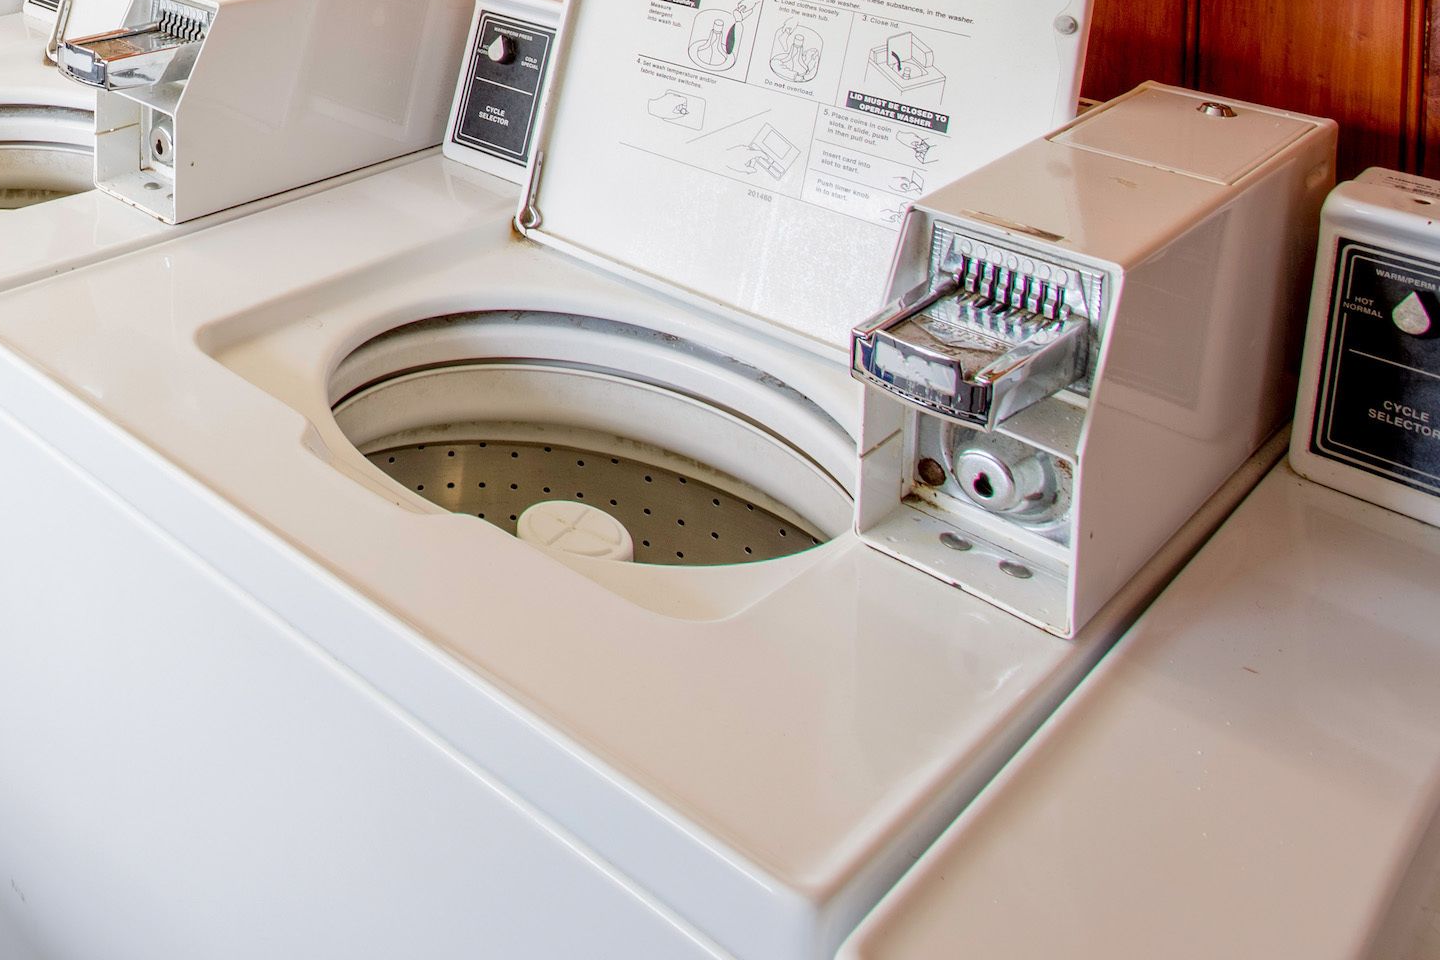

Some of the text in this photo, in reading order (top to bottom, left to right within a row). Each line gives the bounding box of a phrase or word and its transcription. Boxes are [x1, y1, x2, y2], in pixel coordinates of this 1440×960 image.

[837, 0, 860, 9] washer.
[886, 1, 925, 15] substances,
[948, 15, 973, 24] washer.
[521, 61, 539, 70] SPECIAL
[486, 106, 505, 117] CYCLE
[849, 92, 947, 122] LID MUST BE CLOSED TO
[859, 103, 931, 127] OPERATE WASHER.
[479, 111, 509, 126] SELECTOR
[1376, 268, 1435, 290] WARM/PERM
[1343, 302, 1383, 318] NORMAL
[1355, 296, 1374, 306] HOT
[1384, 400, 1430, 422] CYCLE
[1368, 408, 1440, 439] SELECTOR
